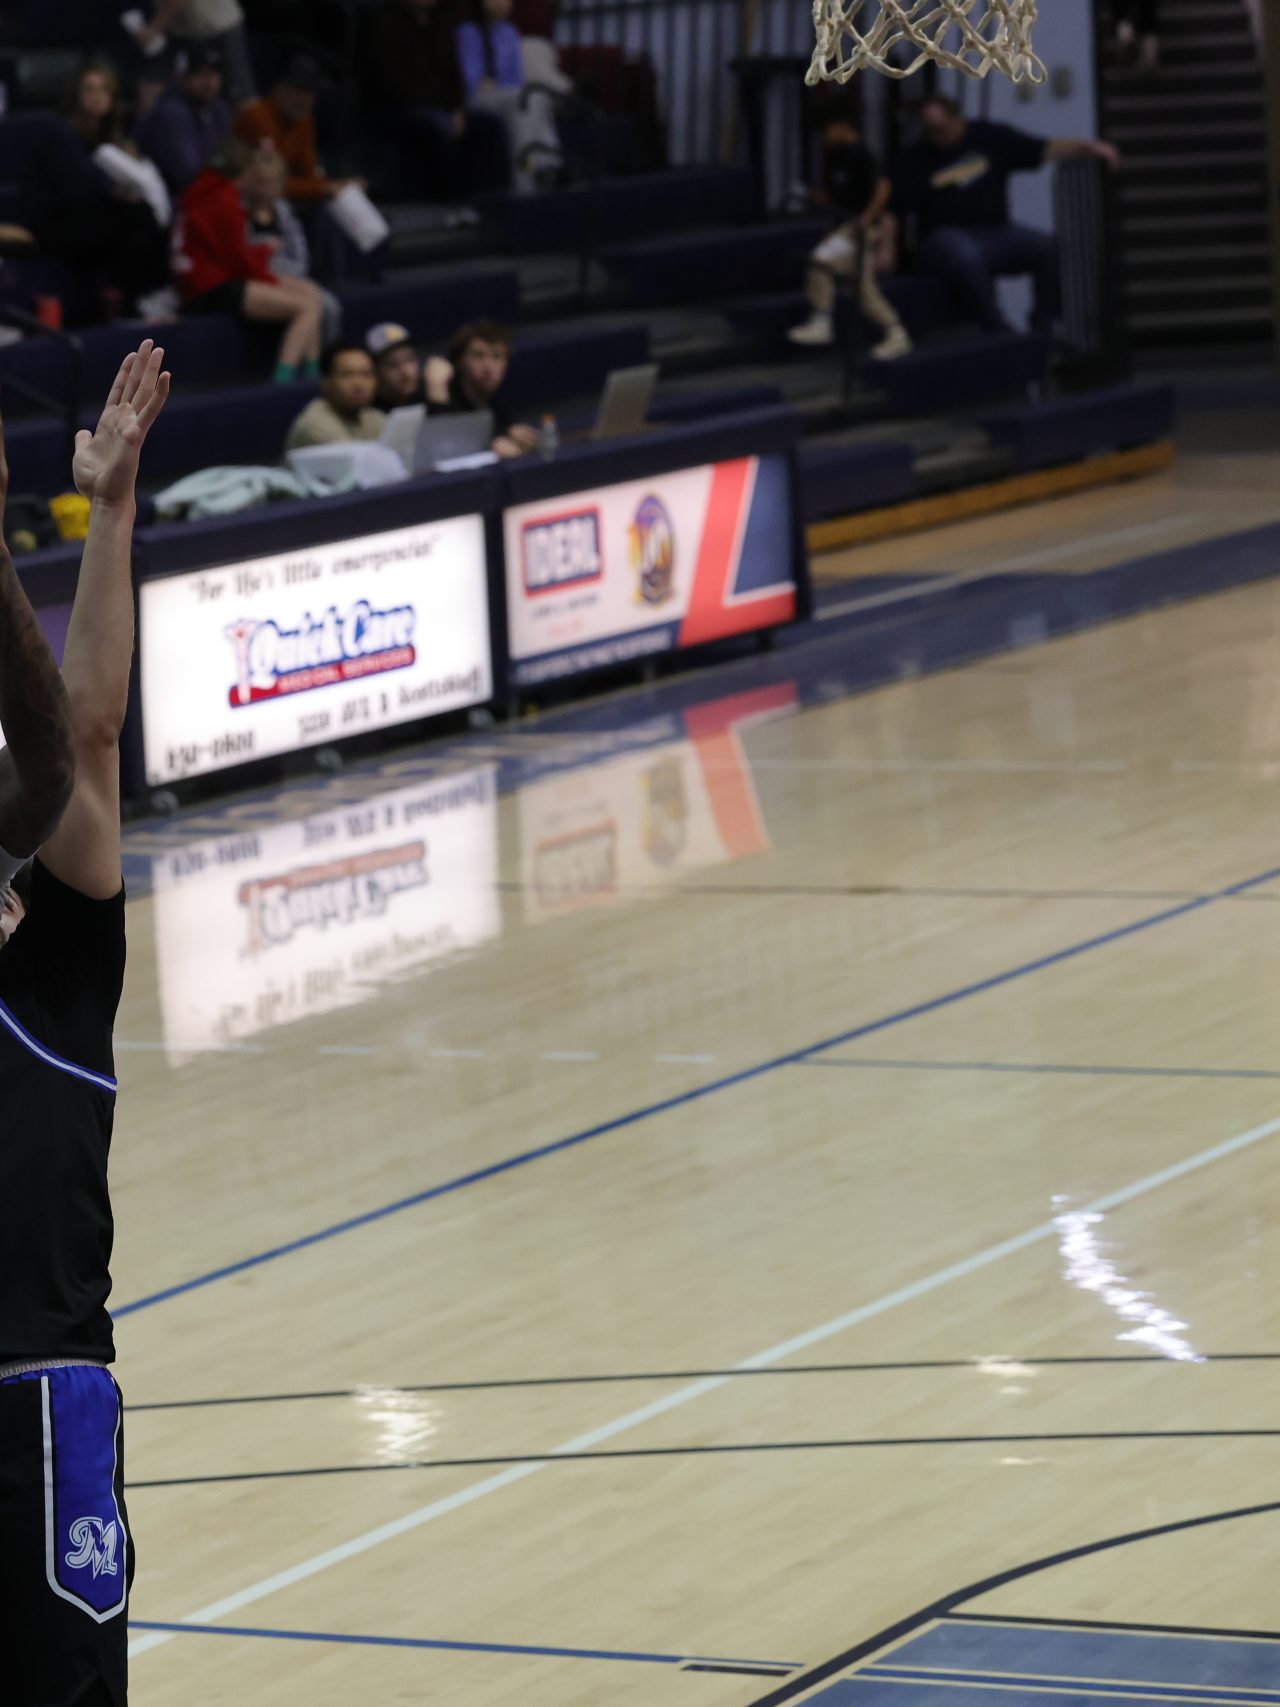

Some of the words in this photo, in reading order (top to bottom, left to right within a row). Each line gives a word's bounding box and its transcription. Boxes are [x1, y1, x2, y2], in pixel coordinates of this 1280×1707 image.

[283, 560, 322, 586] little
[525, 513, 600, 590] IDEAL
[250, 607, 342, 689] Quick
[341, 600, 415, 659] Care
[277, 667, 338, 692] MEDICAL
[342, 649, 412, 677] SERVICES
[65, 1516, 118, 1580] M
